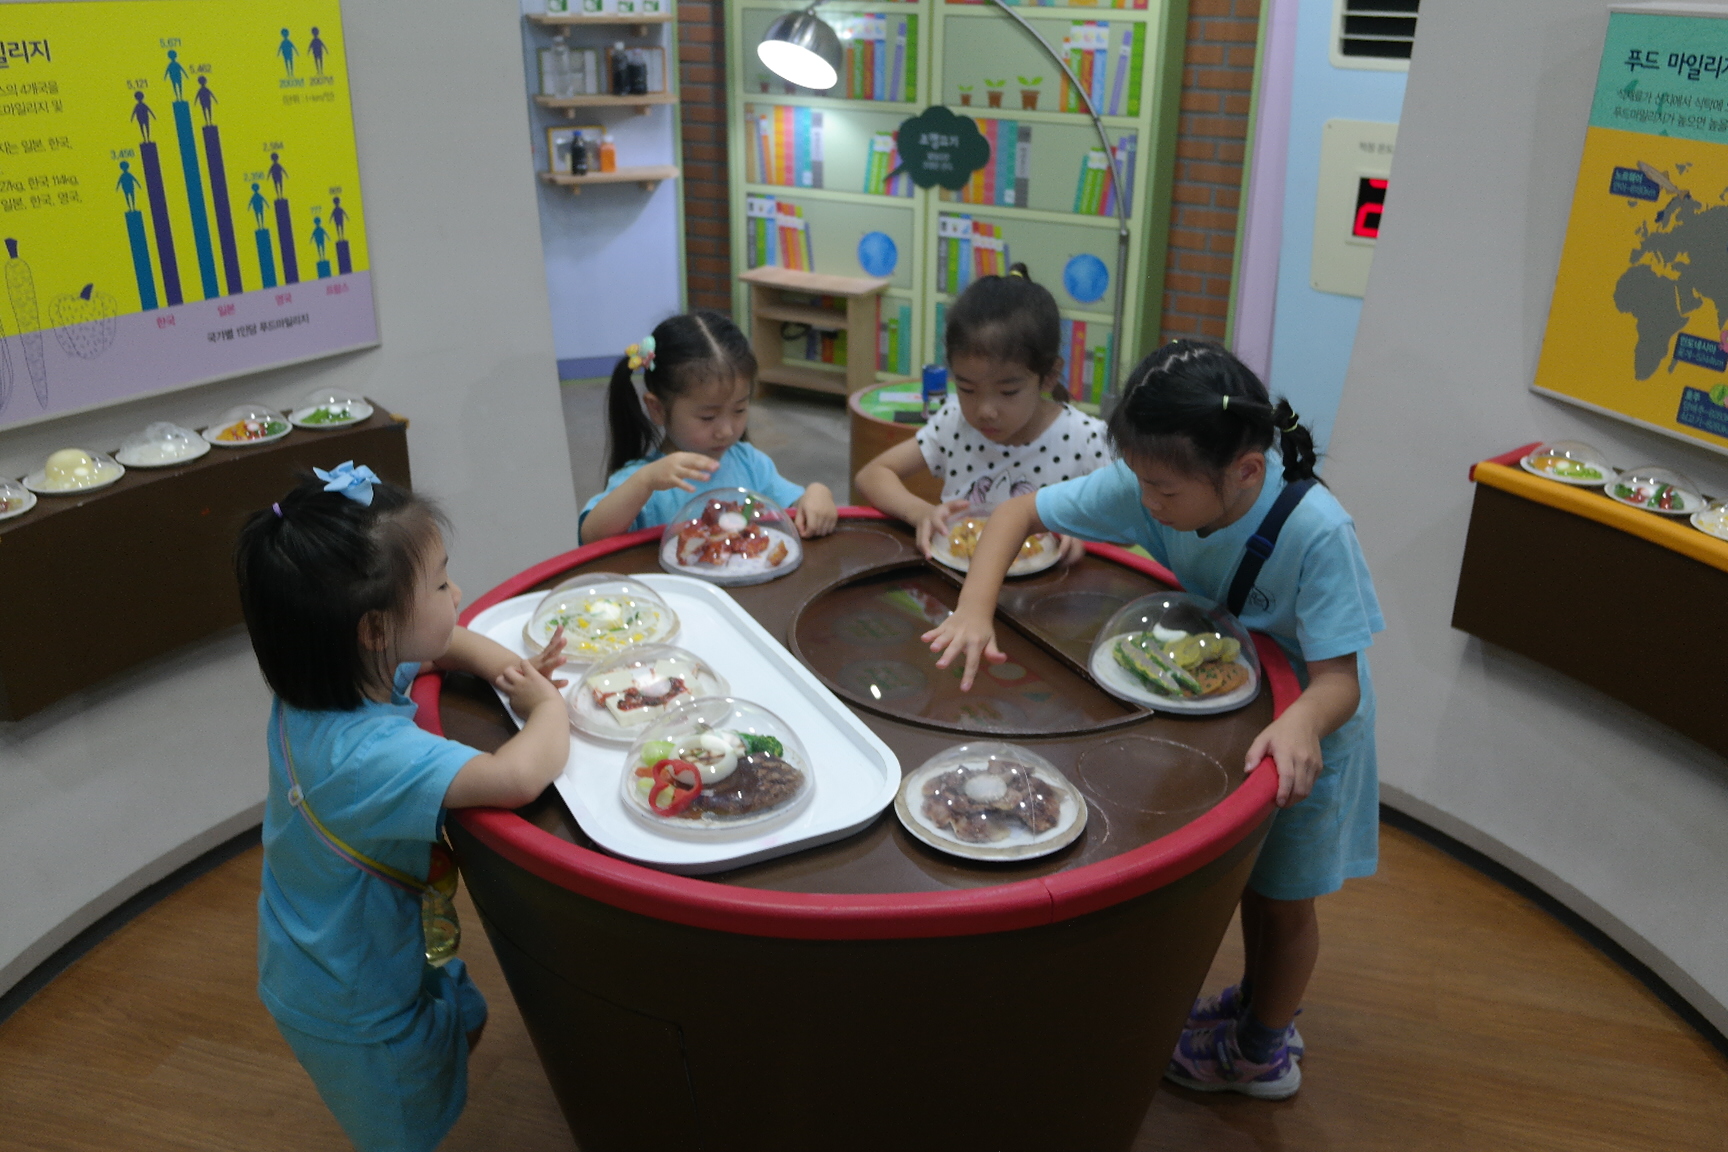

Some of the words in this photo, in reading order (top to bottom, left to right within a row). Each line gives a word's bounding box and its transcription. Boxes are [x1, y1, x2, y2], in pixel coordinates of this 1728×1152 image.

[1624, 49, 1660, 72] 푸드
[217, 303, 235, 318] 일본
[156, 314, 176, 329] 한국
[207, 327, 234, 343] 국가별
